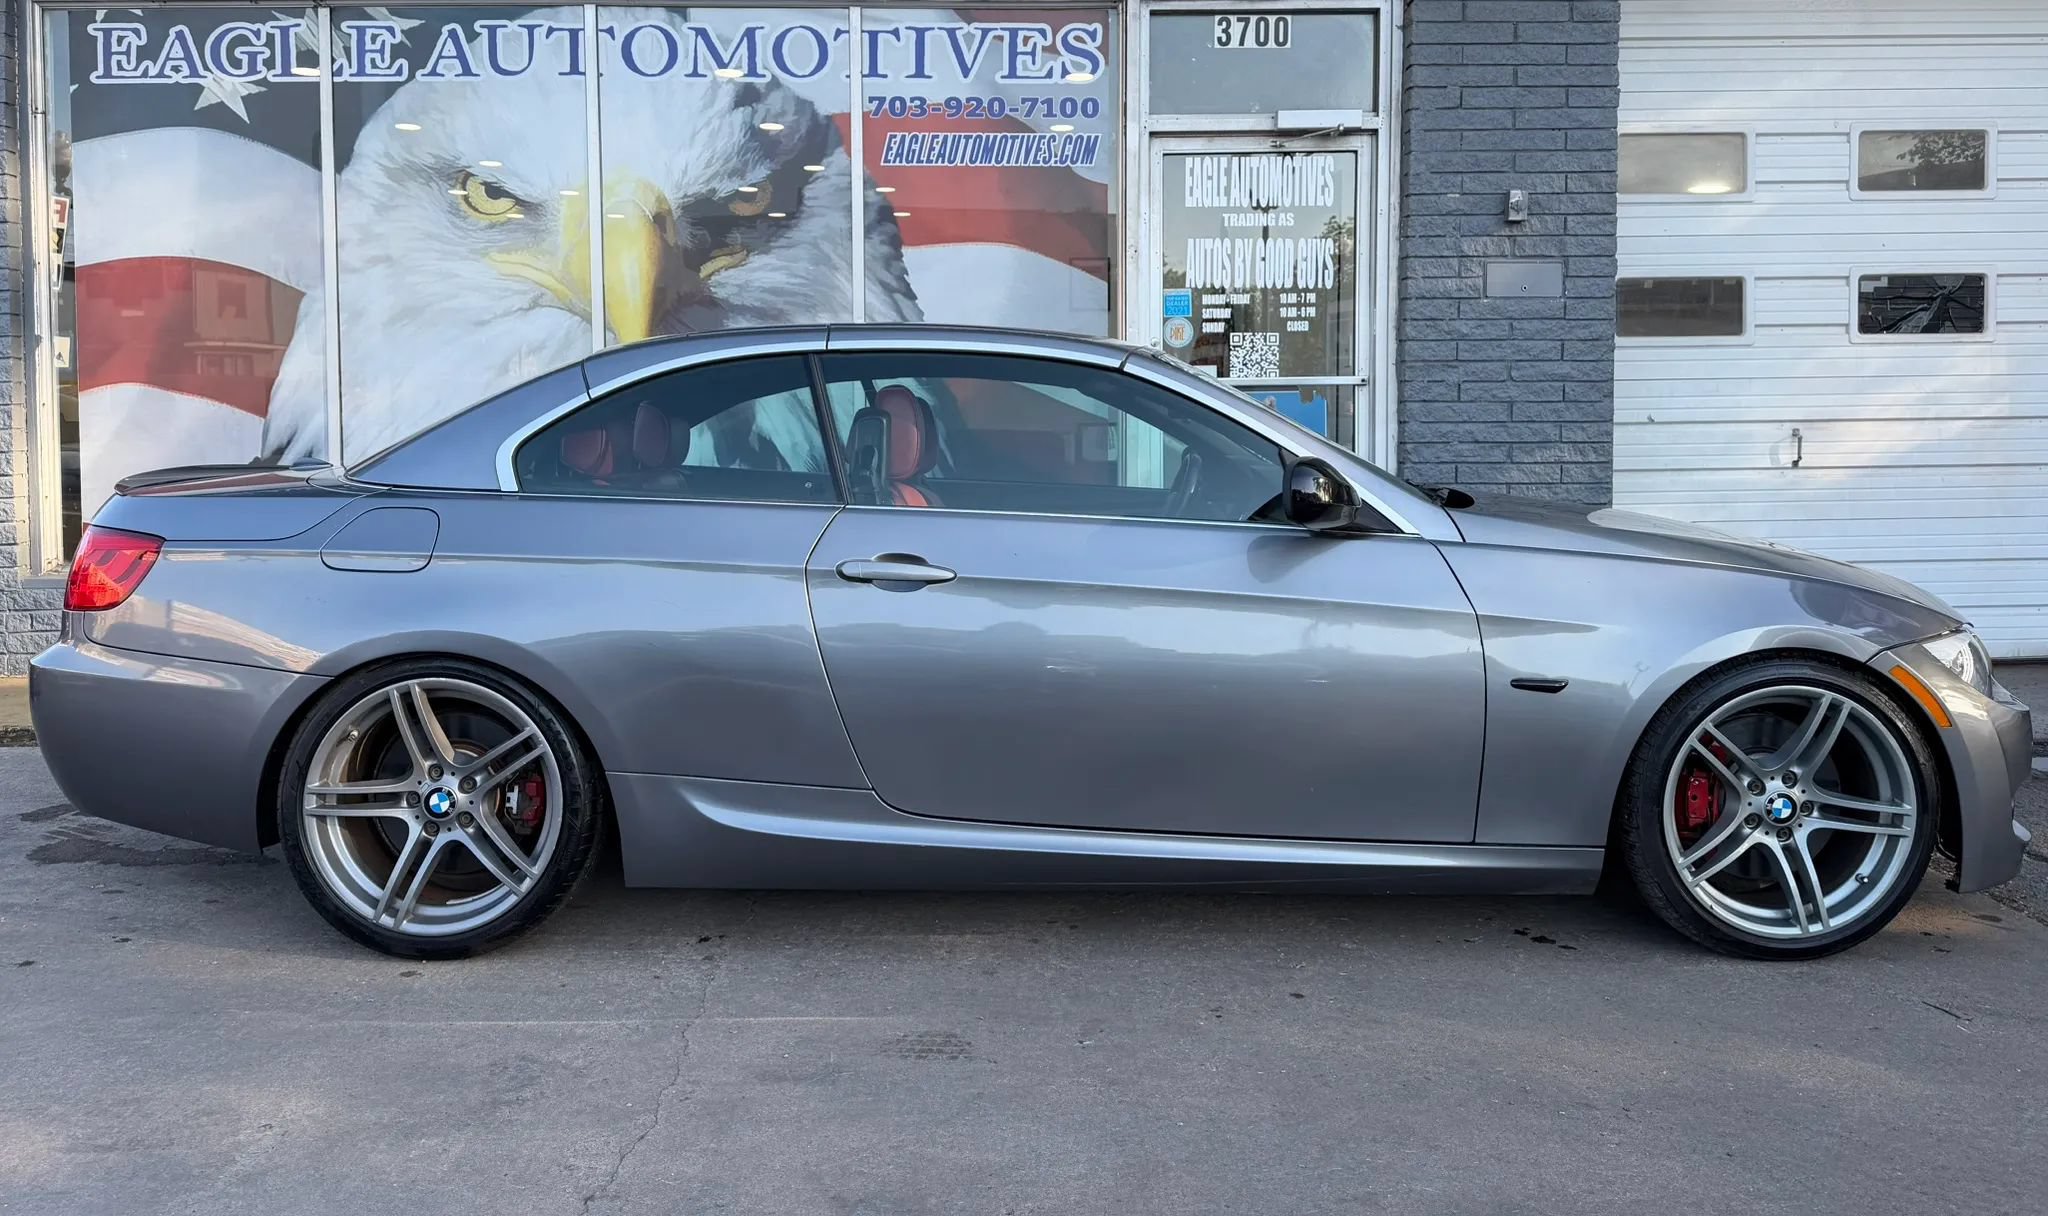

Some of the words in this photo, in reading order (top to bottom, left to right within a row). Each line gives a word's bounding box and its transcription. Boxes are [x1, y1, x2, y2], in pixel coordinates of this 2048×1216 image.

[1216, 16, 1289, 47] 3700
[88, 22, 407, 83] EAGLE
[417, 20, 1104, 83] AUTOMOTIVES
[867, 95, 1101, 119] 703-920-7100
[880, 132, 1102, 167] EAGLEAUTOMOTIVES.COM
[1185, 156, 1228, 207] EAGLE
[1229, 155, 1335, 207] AUTOMOTIVES
[1222, 213, 1276, 227] TRADING
[1278, 212, 1295, 226] AS
[1185, 237, 1232, 289] AUTOS
[1234, 238, 1253, 288] BY
[1255, 237, 1294, 289] GOOD
[1296, 237, 1335, 289] GUYS
[1167, 306, 1189, 315] 2021
[1202, 294, 1226, 305] MONDAY
[1230, 294, 1250, 304] FRIDAY
[1287, 293, 1297, 303] AM
[1301, 293, 1306, 303] 7
[1306, 293, 1316, 303] PM
[1202, 308, 1232, 319] SATURDAY
[1287, 307, 1297, 317] AM
[1306, 306, 1316, 317] PM
[1202, 322, 1226, 333] SUNDAY
[1287, 321, 1309, 331] CLOSED
